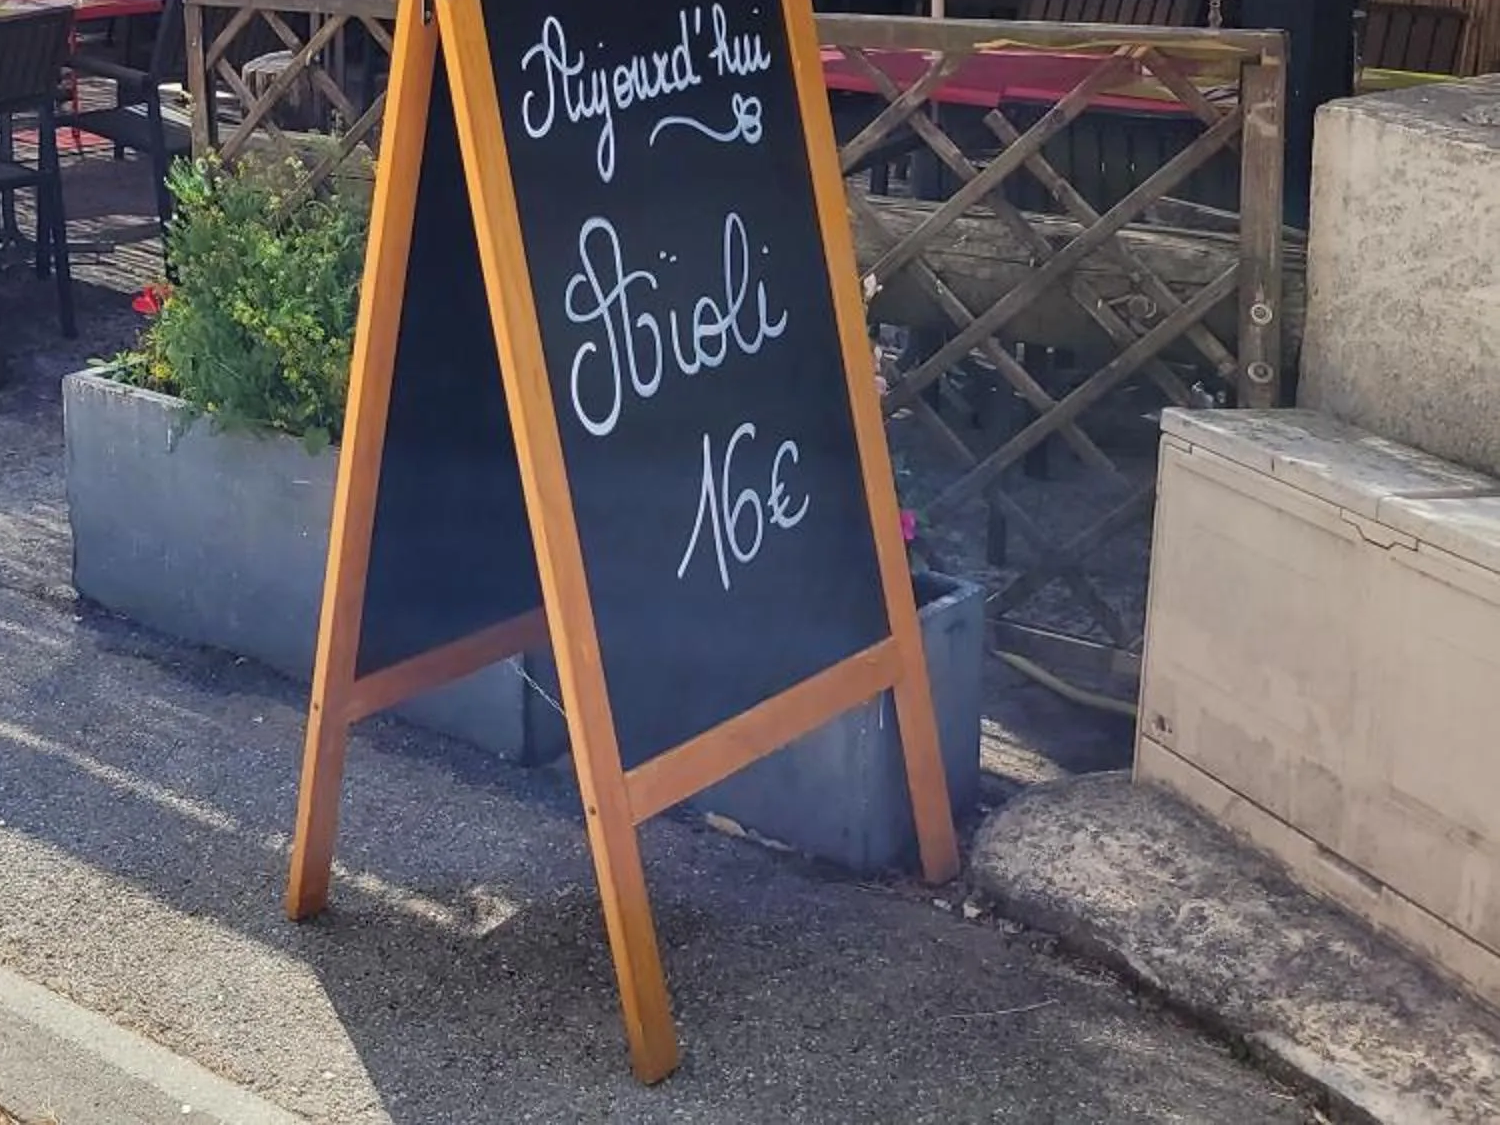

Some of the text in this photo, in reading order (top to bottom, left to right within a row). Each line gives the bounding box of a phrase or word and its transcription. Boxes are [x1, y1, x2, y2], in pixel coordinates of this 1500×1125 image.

[521, 2, 771, 183] Aujourd'hui
[565, 213, 787, 436] Aïoli
[677, 423, 809, 591] 16€
